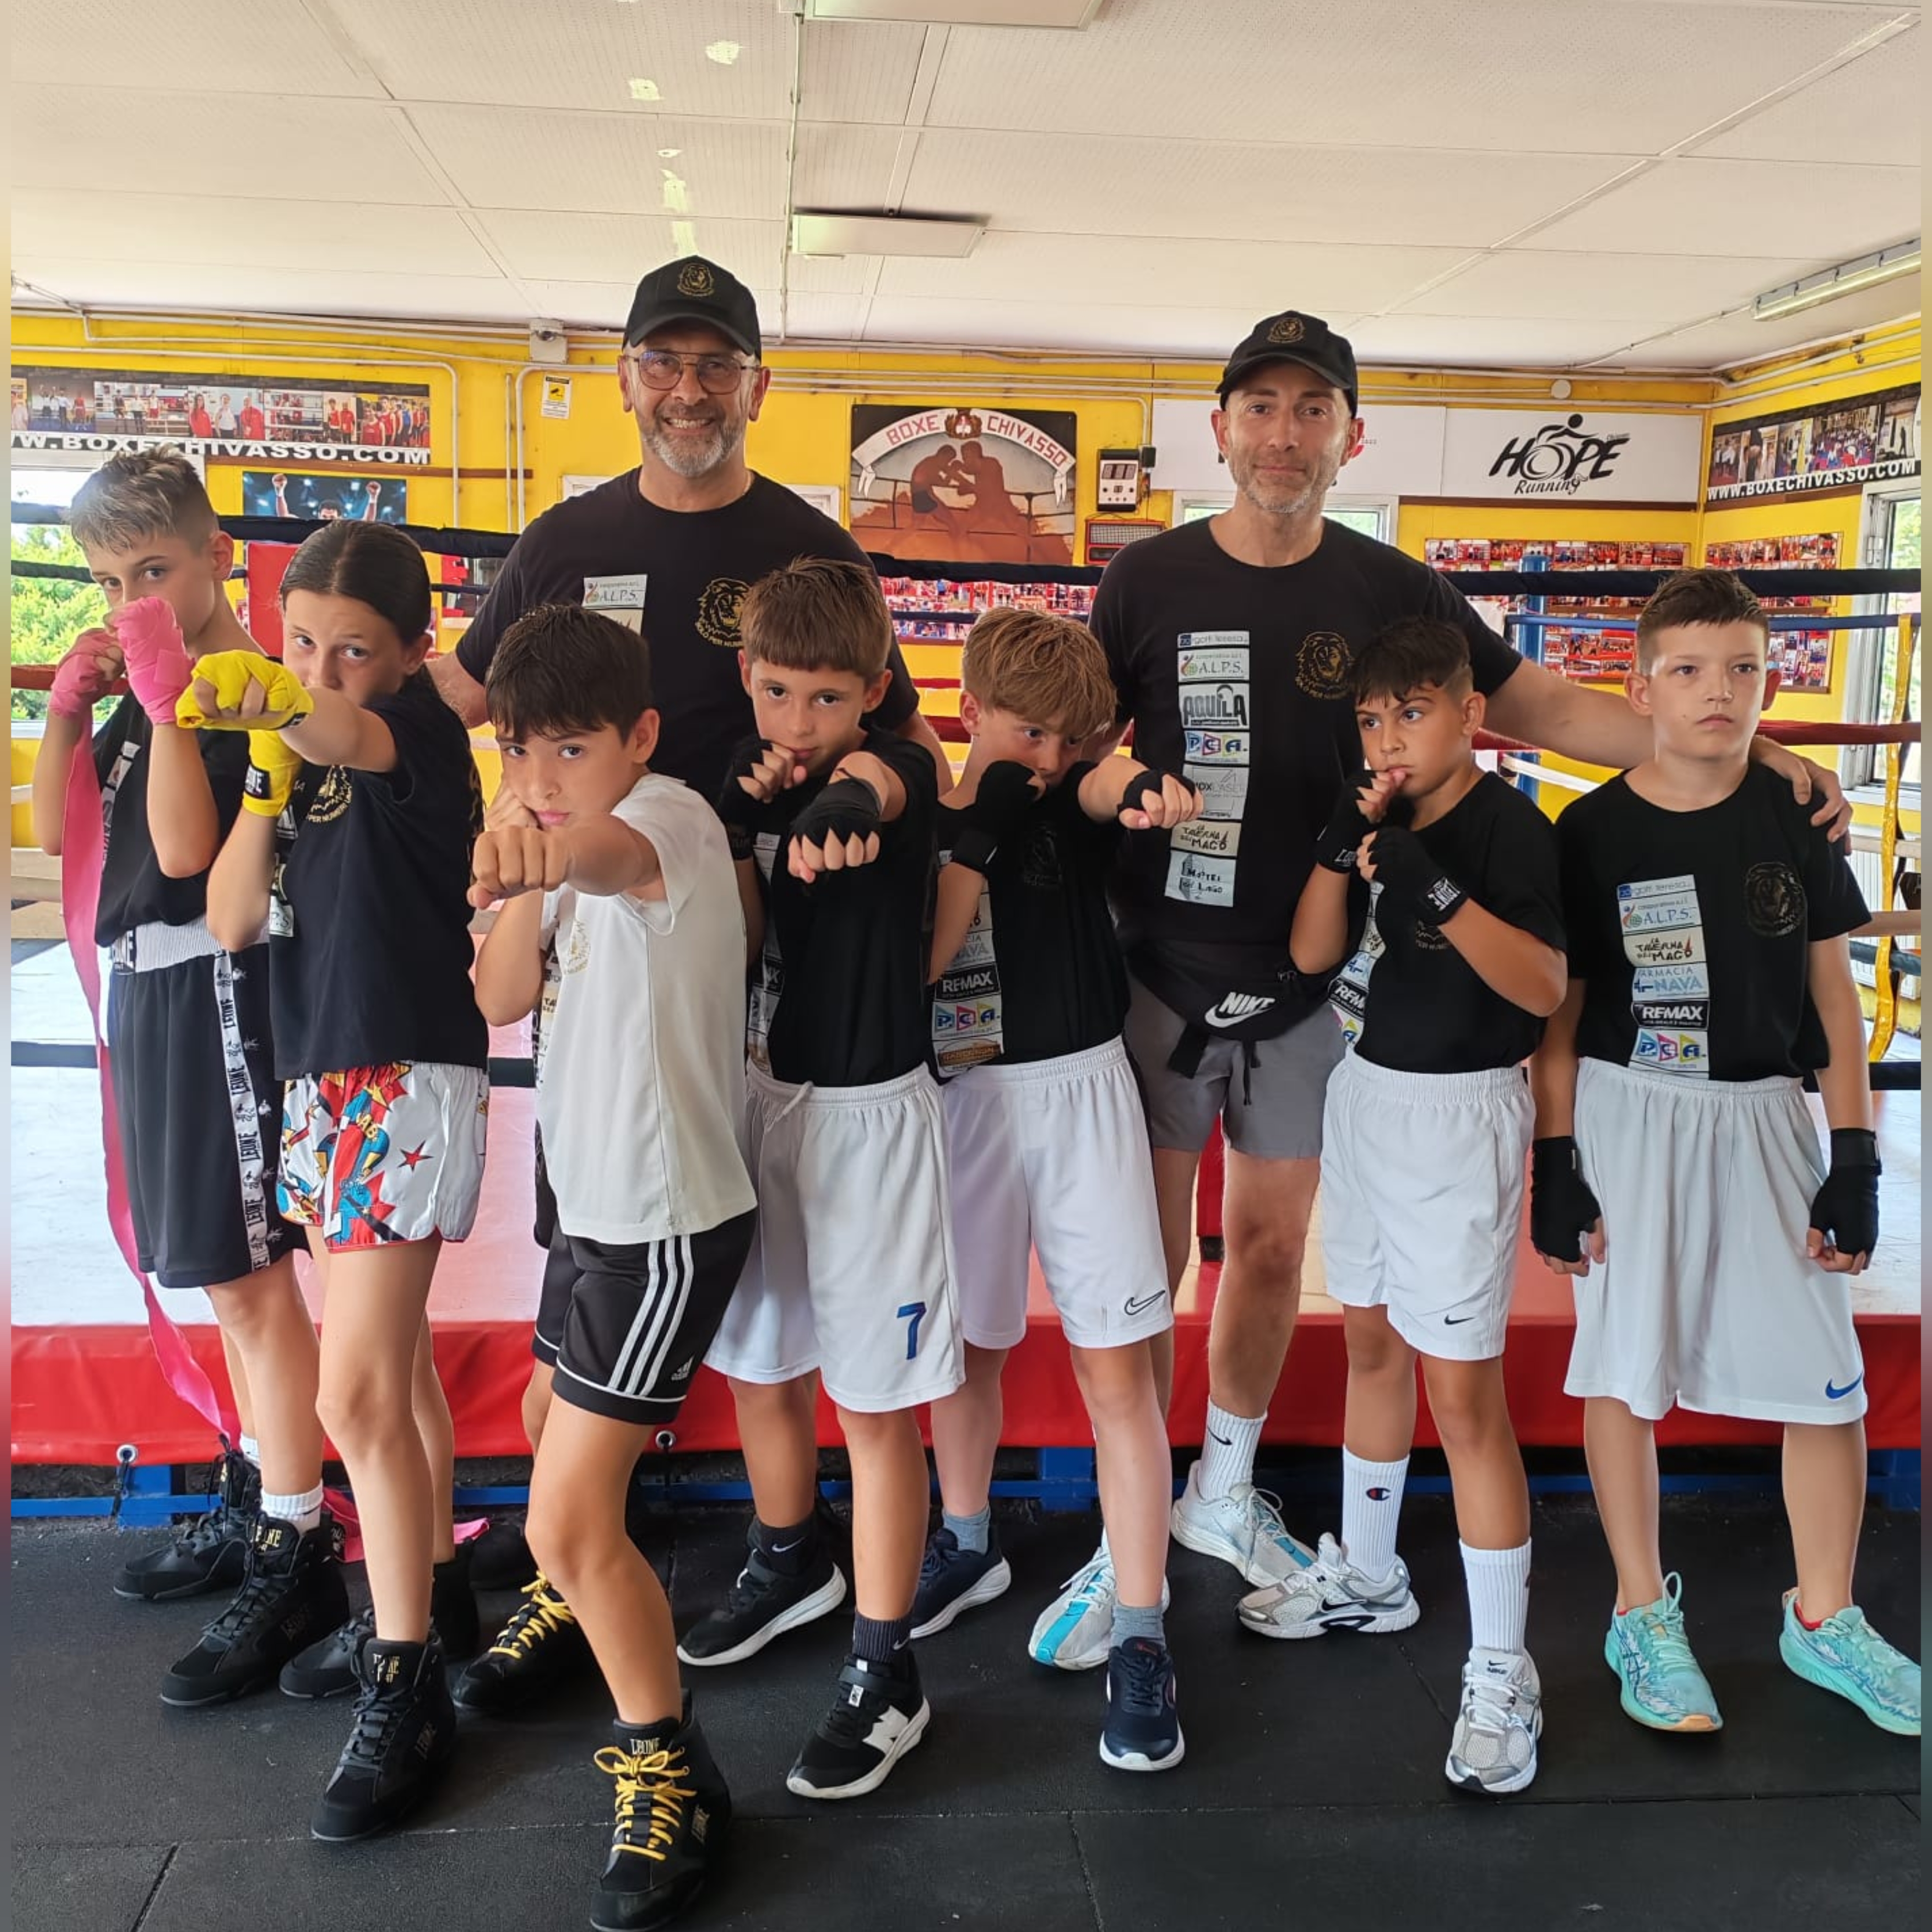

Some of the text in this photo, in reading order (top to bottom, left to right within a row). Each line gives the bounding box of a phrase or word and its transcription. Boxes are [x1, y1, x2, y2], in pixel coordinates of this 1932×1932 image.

[886, 415, 1067, 467] BOXE CHIVASSO
[1489, 435, 1631, 480] HOPE
[1514, 475, 1582, 495] Running
[1707, 459, 1916, 500] WWW.BOXECHIVASSO.COM
[1199, 661, 1243, 674] A.L.P.S.
[1644, 907, 1692, 925] A.L.P.S.
[942, 972, 994, 993] REMAX
[1638, 966, 1693, 977] FARMACIA
[1654, 976, 1703, 991] NAVA
[1218, 991, 1275, 1015] NIKE
[1642, 1006, 1704, 1020] REMAX
[227, 1064, 251, 1096] LEONE
[238, 1130, 261, 1162] LEONE
[244, 1196, 265, 1227] LEONE
[897, 1301, 926, 1360] 7
